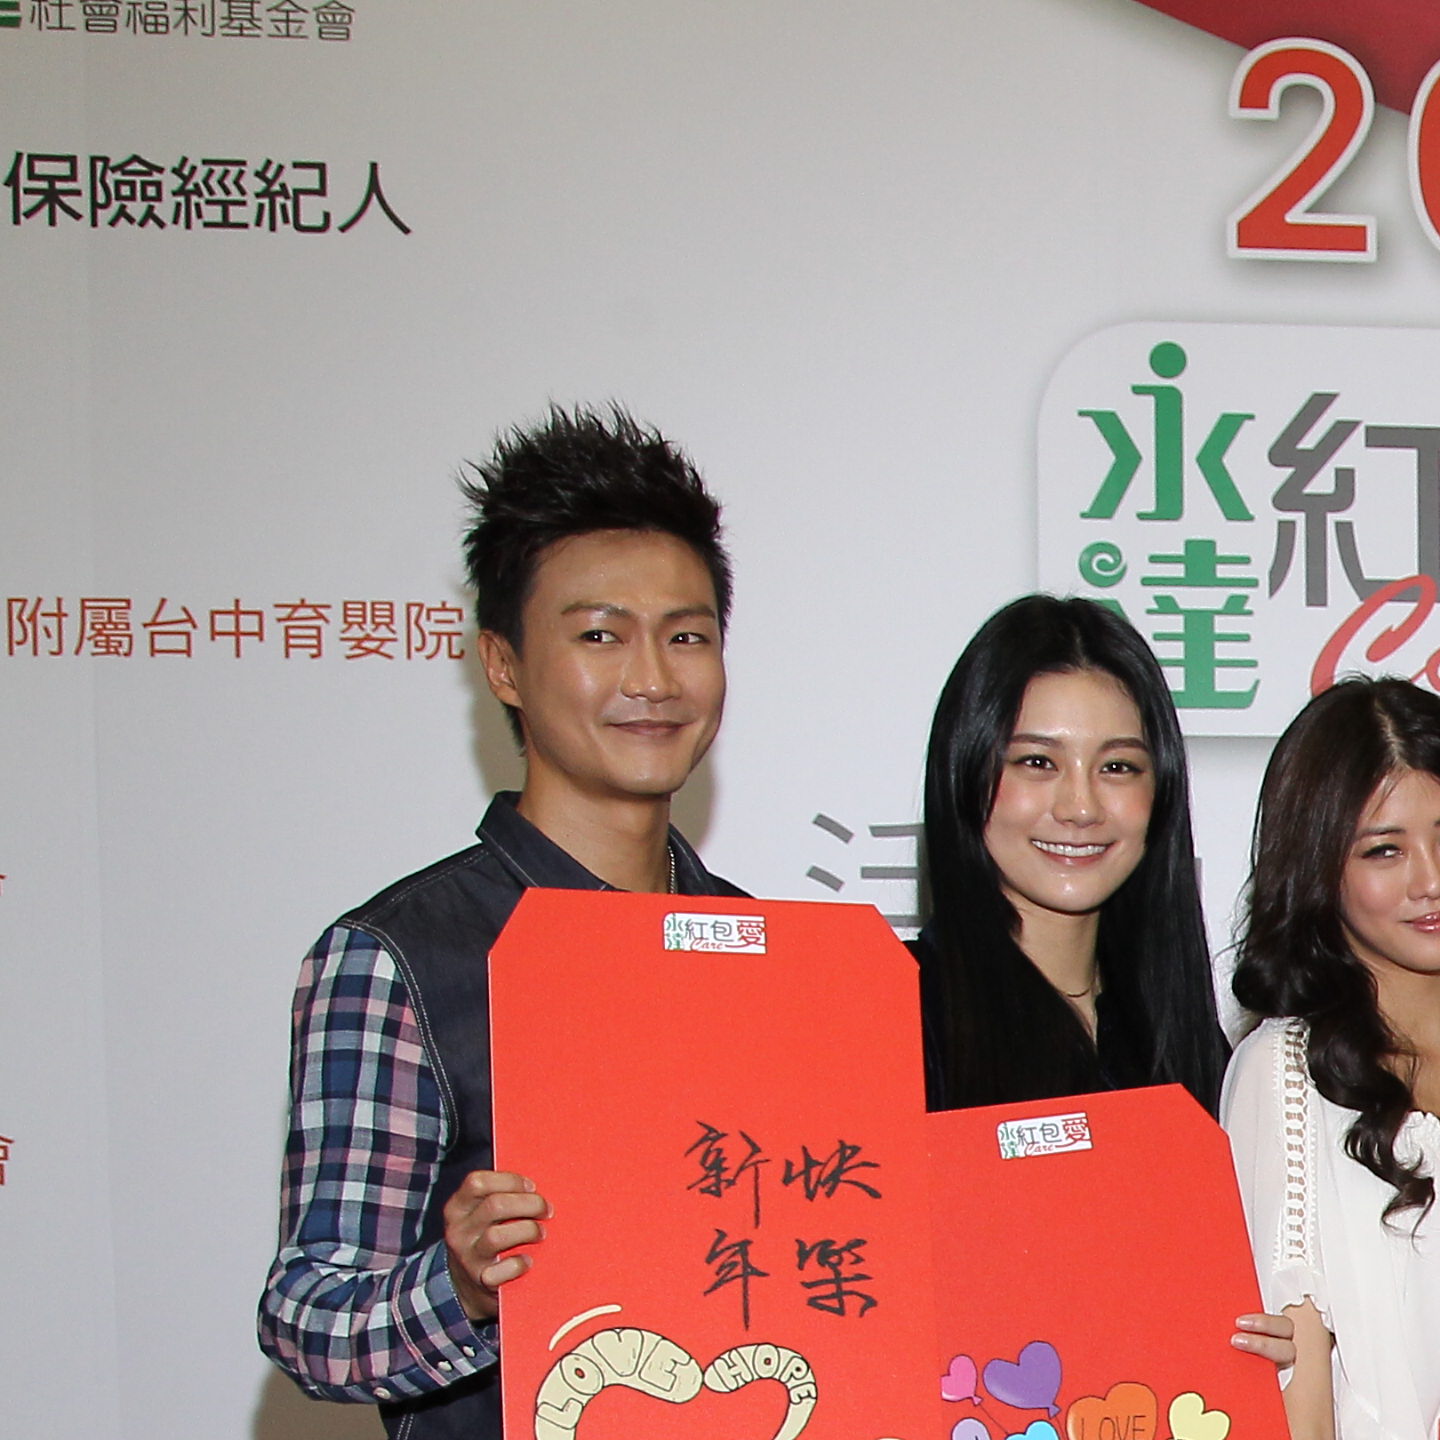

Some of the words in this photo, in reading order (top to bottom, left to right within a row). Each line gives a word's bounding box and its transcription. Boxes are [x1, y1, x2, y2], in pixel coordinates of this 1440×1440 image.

[29, 0, 356, 42] 社會福利基金會
[3, 150, 412, 237] 保險經紀人
[5, 596, 467, 663] 附屬台中育嬰院
[535, 1328, 692, 1430] LOVE
[720, 1343, 818, 1406] HOPE
